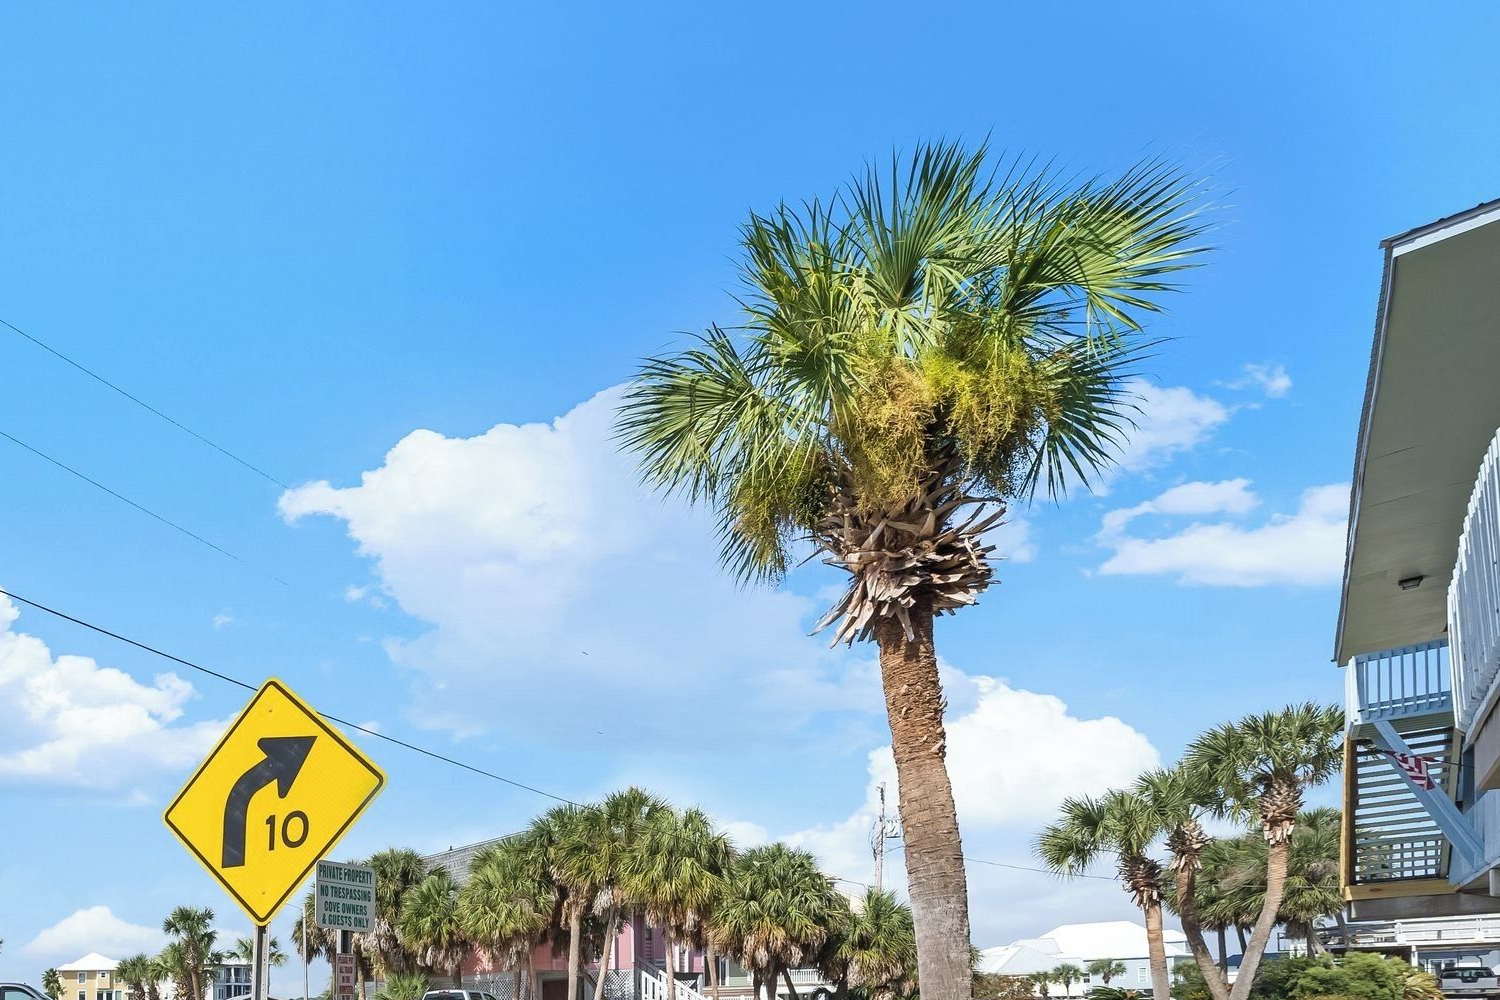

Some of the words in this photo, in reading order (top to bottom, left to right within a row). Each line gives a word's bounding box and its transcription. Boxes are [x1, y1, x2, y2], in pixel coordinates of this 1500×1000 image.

[265, 810, 310, 852] 10
[318, 864, 342, 880] PRIVATE
[343, 868, 372, 885] PROPERTY
[320, 884, 329, 897] NO
[330, 885, 371, 902] TRESPASSING
[324, 900, 340, 913] COVE
[341, 902, 368, 916] OWNERS
[322, 913, 326, 924] &
[328, 914, 352, 927] GUESTS
[353, 916, 370, 928] ONLY
